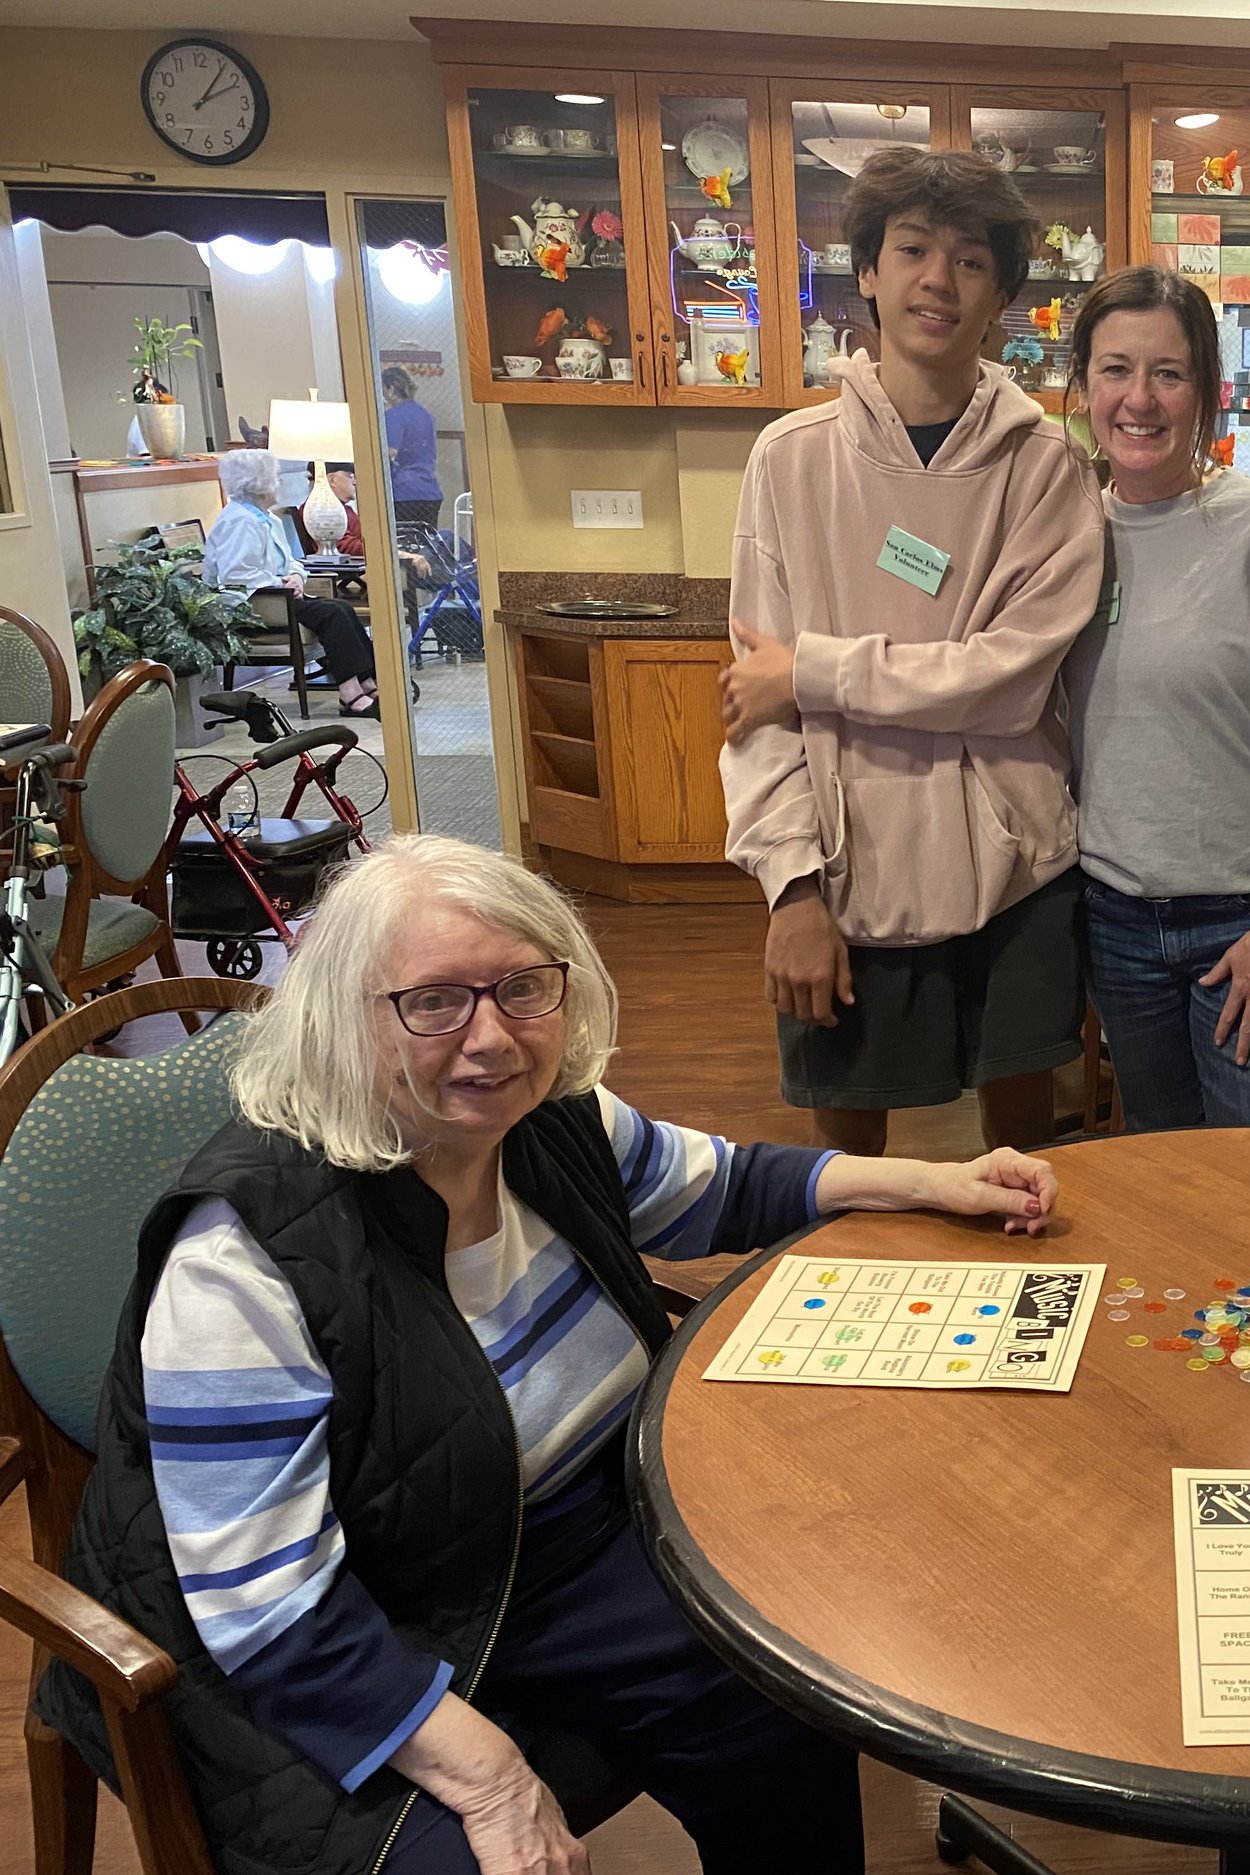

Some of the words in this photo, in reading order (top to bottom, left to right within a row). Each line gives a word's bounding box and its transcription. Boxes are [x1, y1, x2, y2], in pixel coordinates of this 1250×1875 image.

[172, 57, 184, 72] 11
[192, 52, 207, 68] 12
[160, 72, 175, 87] 10
[230, 73, 241, 88] 2
[156, 92, 166, 106] 9
[240, 96, 250, 111] 3
[165, 113, 175, 128] 8
[237, 117, 245, 130] 4
[184, 128, 194, 143] 7
[204, 135, 213, 149] 6
[224, 130, 233, 145] 5
[886, 540, 899, 551] San
[900, 548, 923, 564] Carlos
[925, 560, 943, 574] Elms
[893, 553, 929, 576] Volunteer
